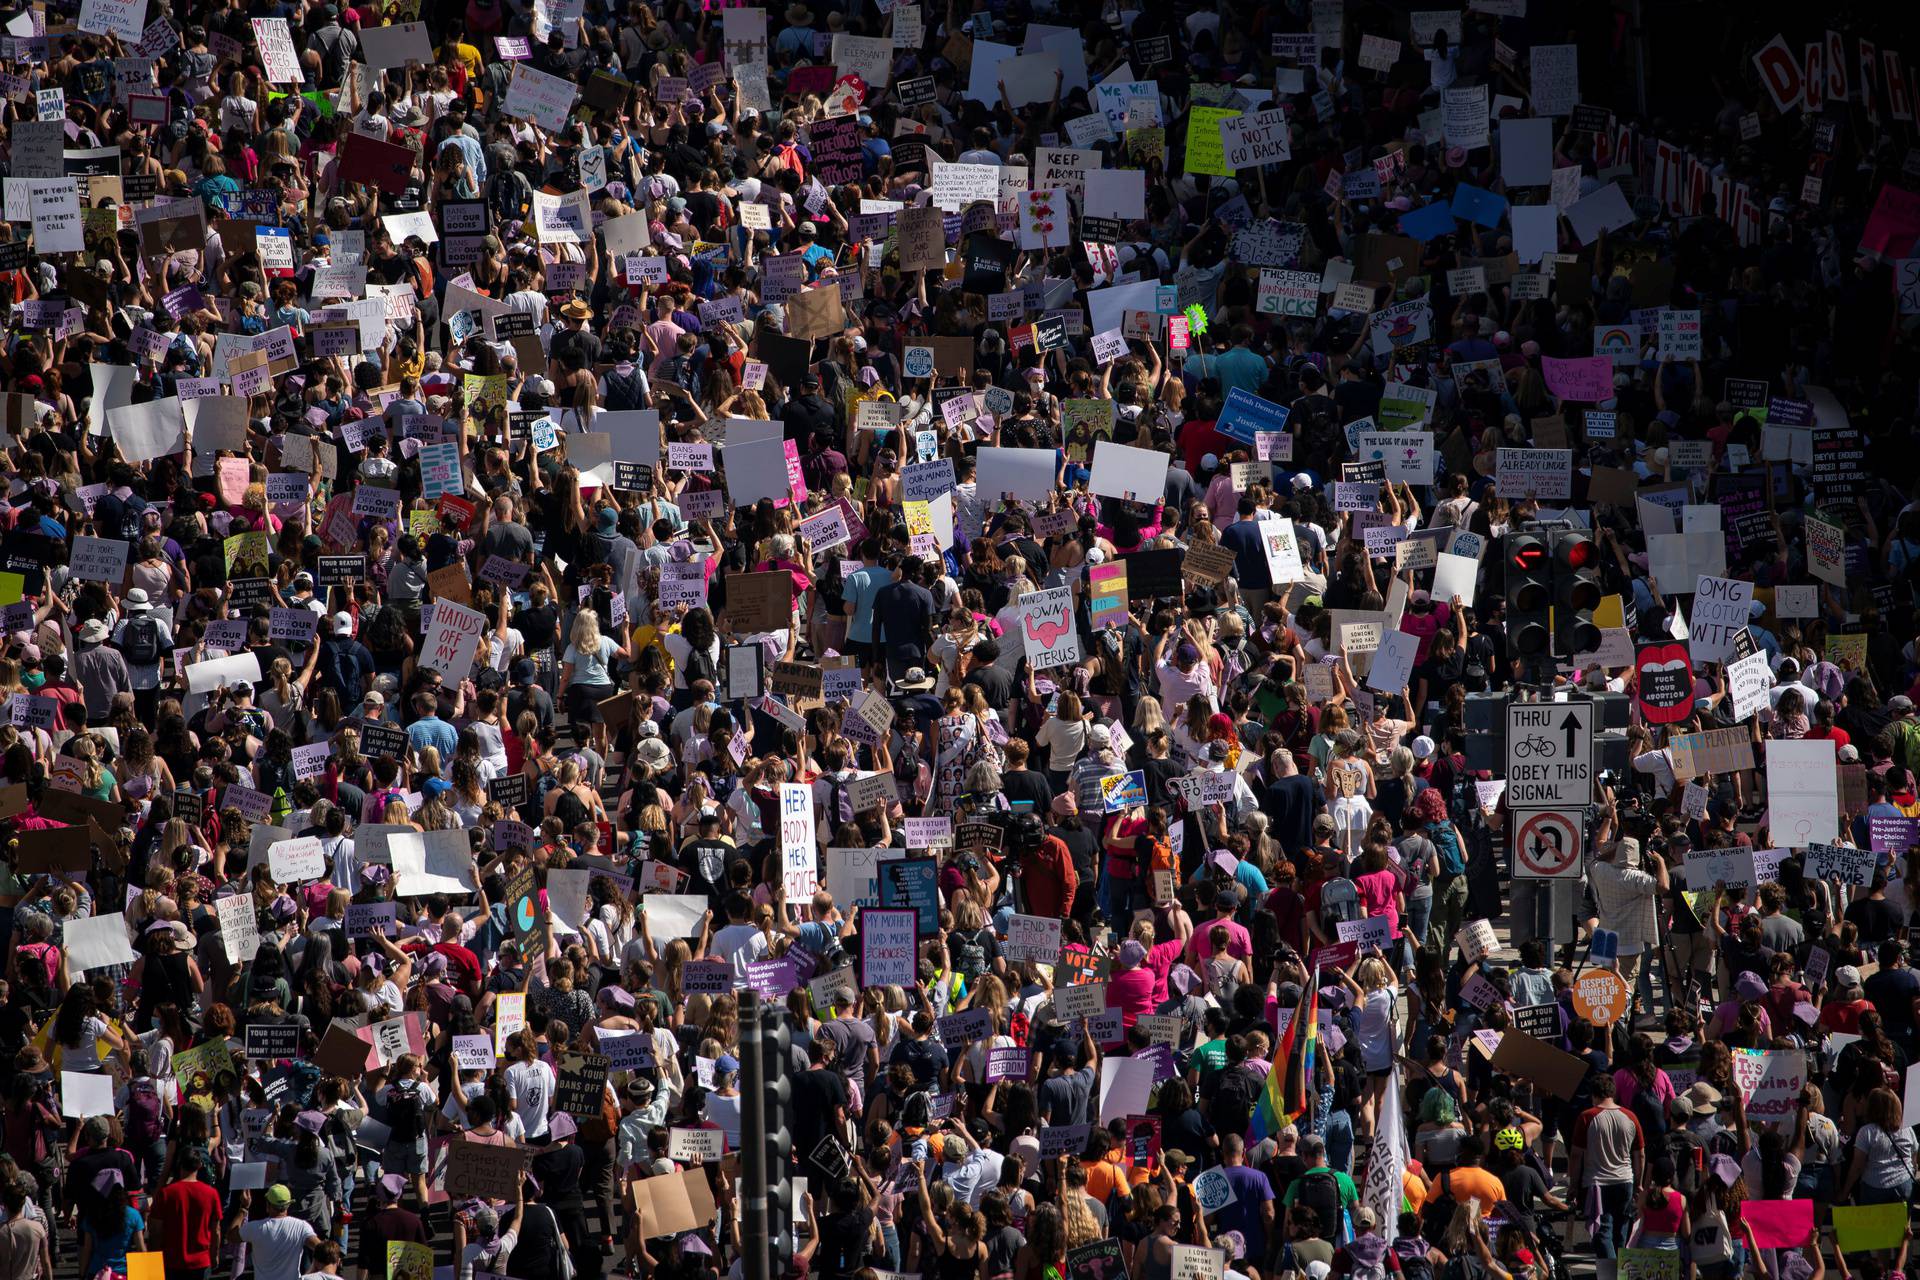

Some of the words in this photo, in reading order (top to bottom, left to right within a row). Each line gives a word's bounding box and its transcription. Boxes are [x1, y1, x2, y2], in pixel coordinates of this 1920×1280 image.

[253, 19, 291, 41] MOTHERS
[263, 52, 291, 66] GREG
[844, 48, 887, 61] ELEPHANT
[1099, 86, 1121, 97] We
[1225, 117, 1247, 131] WE
[1254, 112, 1284, 126] WILL
[814, 133, 860, 153] THEOLOGY
[1241, 127, 1271, 145] NOT
[1047, 152, 1080, 165] KEEP
[1231, 147, 1247, 164] GO
[1253, 140, 1285, 159] BACK
[33, 188, 49, 196] NOT
[52, 185, 74, 195] YOUR
[43, 196, 66, 204] BODY
[36, 214, 50, 222] NOT
[54, 213, 76, 221] YOUR
[47, 222, 67, 231] CALL
[644, 267, 663, 275] OUR
[1262, 269, 1285, 280] THIS
[1287, 271, 1320, 284] EPISODE
[1263, 296, 1318, 316] SUCKS
[1231, 391, 1255, 406] Jewish
[1255, 401, 1275, 414] Dems
[1274, 409, 1287, 418] for
[1237, 415, 1264, 431] Justice
[1814, 431, 1831, 441] BLACK
[1836, 430, 1859, 438] WOMEN
[1502, 450, 1518, 459] THE
[1522, 450, 1555, 459] BURDEN
[1556, 450, 1566, 459] IS
[1500, 461, 1541, 470] ALREADY
[1542, 461, 1568, 470] UNDUE
[926, 469, 952, 481] MINDS
[1699, 578, 1742, 601] OMG
[1020, 595, 1044, 606] MIND
[1046, 589, 1070, 602] YOUR
[1032, 604, 1062, 619] OWN
[1694, 601, 1750, 625] SCOTUS
[436, 603, 480, 635] HANDS
[440, 629, 463, 648] OFF
[1691, 622, 1740, 646] WTF
[435, 645, 458, 662] MY
[1028, 646, 1076, 668] UTERUS
[1645, 691, 1684, 700] ABORTION
[1513, 710, 1551, 727] THRU
[1512, 764, 1550, 780] OBEY
[1556, 764, 1588, 780] THIS
[1512, 784, 1563, 800] SIGNAL
[785, 789, 806, 815] HER
[1872, 818, 1912, 826] Pro-Freedom.
[784, 820, 808, 844] BODY
[789, 846, 808, 867] HER
[1688, 851, 1717, 860] REASONS
[1720, 848, 1745, 857] WOMEN
[1810, 842, 1824, 851] THE
[1826, 845, 1870, 859] ELEPHANT
[1819, 861, 1832, 869] IN
[1841, 862, 1861, 872] THE
[1816, 868, 1865, 885] WOMB
[784, 870, 817, 898] CHOICE
[865, 914, 879, 928] MY
[881, 914, 913, 928] MOTHER
[1023, 920, 1045, 932] END
[869, 933, 886, 944] HAD
[890, 933, 911, 944] MORE
[1016, 931, 1051, 944] FORCED
[1009, 944, 1060, 957] MOTHERHOOD
[747, 962, 788, 972] Reproductive
[866, 961, 887, 972] THAN
[893, 961, 906, 973] MY
[749, 971, 775, 980] Freedom
[873, 974, 912, 985] DAUGHTER
[1580, 976, 1616, 990] RESPECT
[1577, 987, 1608, 1000] WOMEN
[1609, 985, 1620, 995] OF
[1586, 996, 1614, 1007] COLOR
[586, 1056, 608, 1067] KEEP
[990, 1049, 1016, 1060] ABORTION
[1018, 1049, 1026, 1058] IS
[989, 1061, 1026, 1076] FREEDOM
[1739, 1058, 1763, 1076] It's
[582, 1070, 604, 1081] YOUR
[1741, 1074, 1800, 1091] Giving
[560, 1080, 581, 1091] BANS
[584, 1083, 601, 1093] OFF
[571, 1093, 585, 1102] MY
[563, 1102, 594, 1114] BODY!
[1103, 1246, 1118, 1256] US
